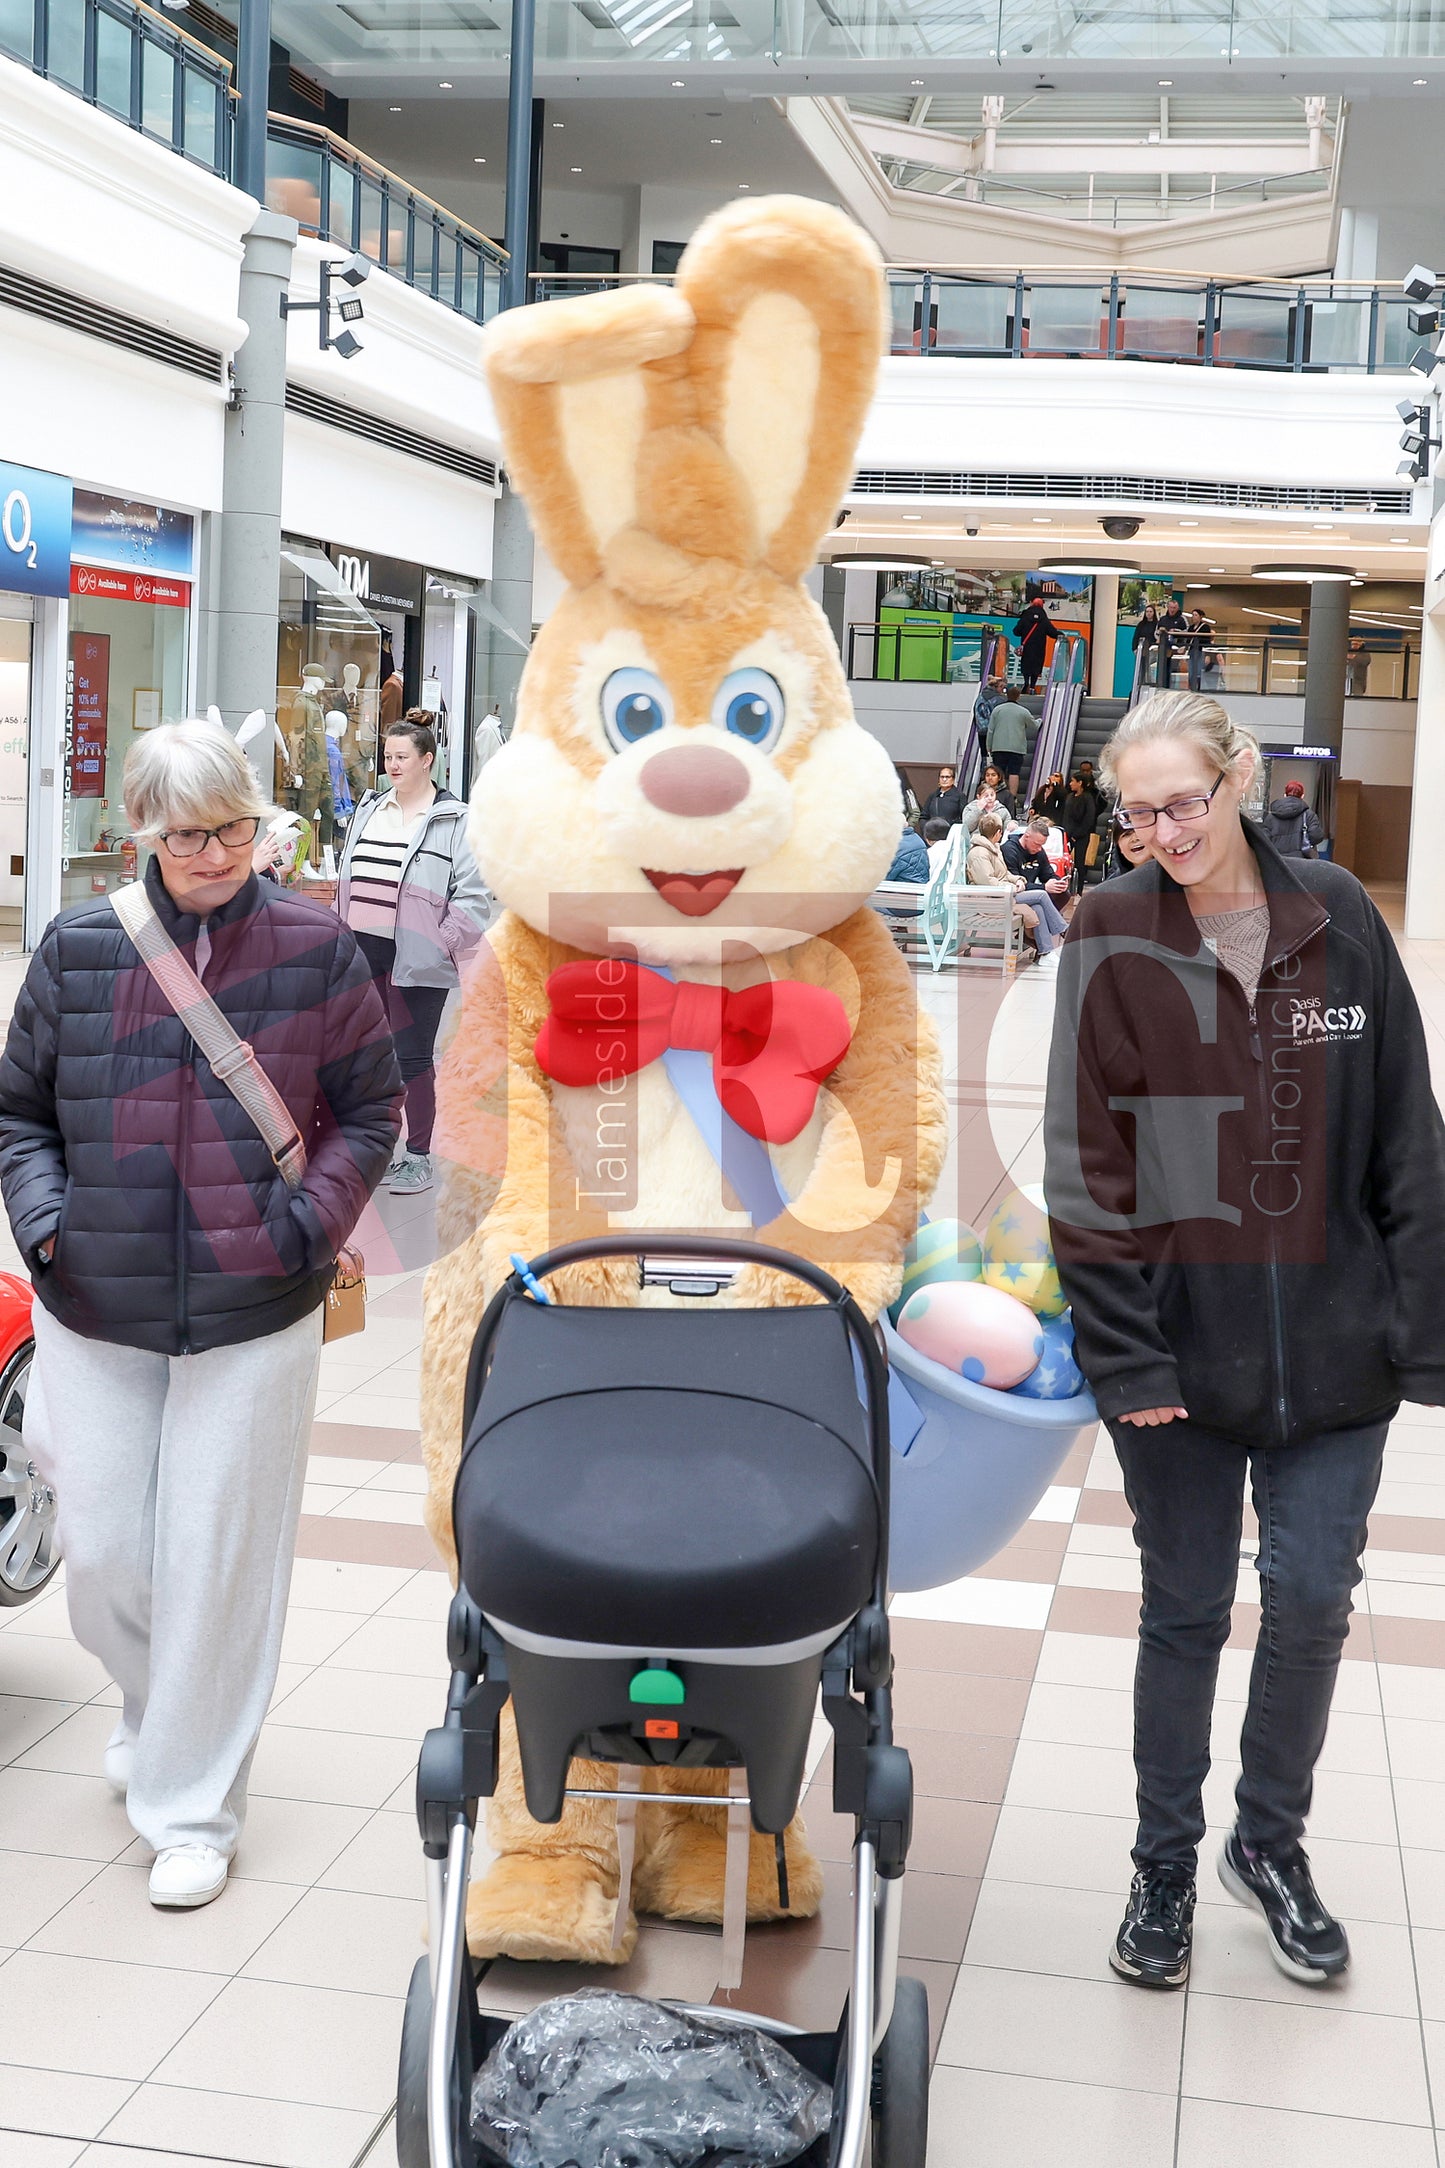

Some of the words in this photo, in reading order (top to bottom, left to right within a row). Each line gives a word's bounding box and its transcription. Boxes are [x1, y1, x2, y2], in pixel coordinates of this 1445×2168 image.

[2, 489, 37, 569] O2
[98, 578, 117, 589] Available
[117, 580, 127, 591] here
[152, 586, 169, 596] Available
[169, 588, 179, 598] here
[78, 676, 89, 689] Get
[78, 694, 90, 705] 10%
[90, 693, 98, 705] off
[65, 660, 74, 761] ESSENTIAL
[1293, 746, 1331, 756] PHOTOS
[63, 766, 72, 803] FOR
[1289, 996, 1322, 1012] Oasis
[1292, 1008, 1349, 1037] PACS
[1293, 1036, 1314, 1046] Parent
[1315, 1034, 1328, 1043] and
